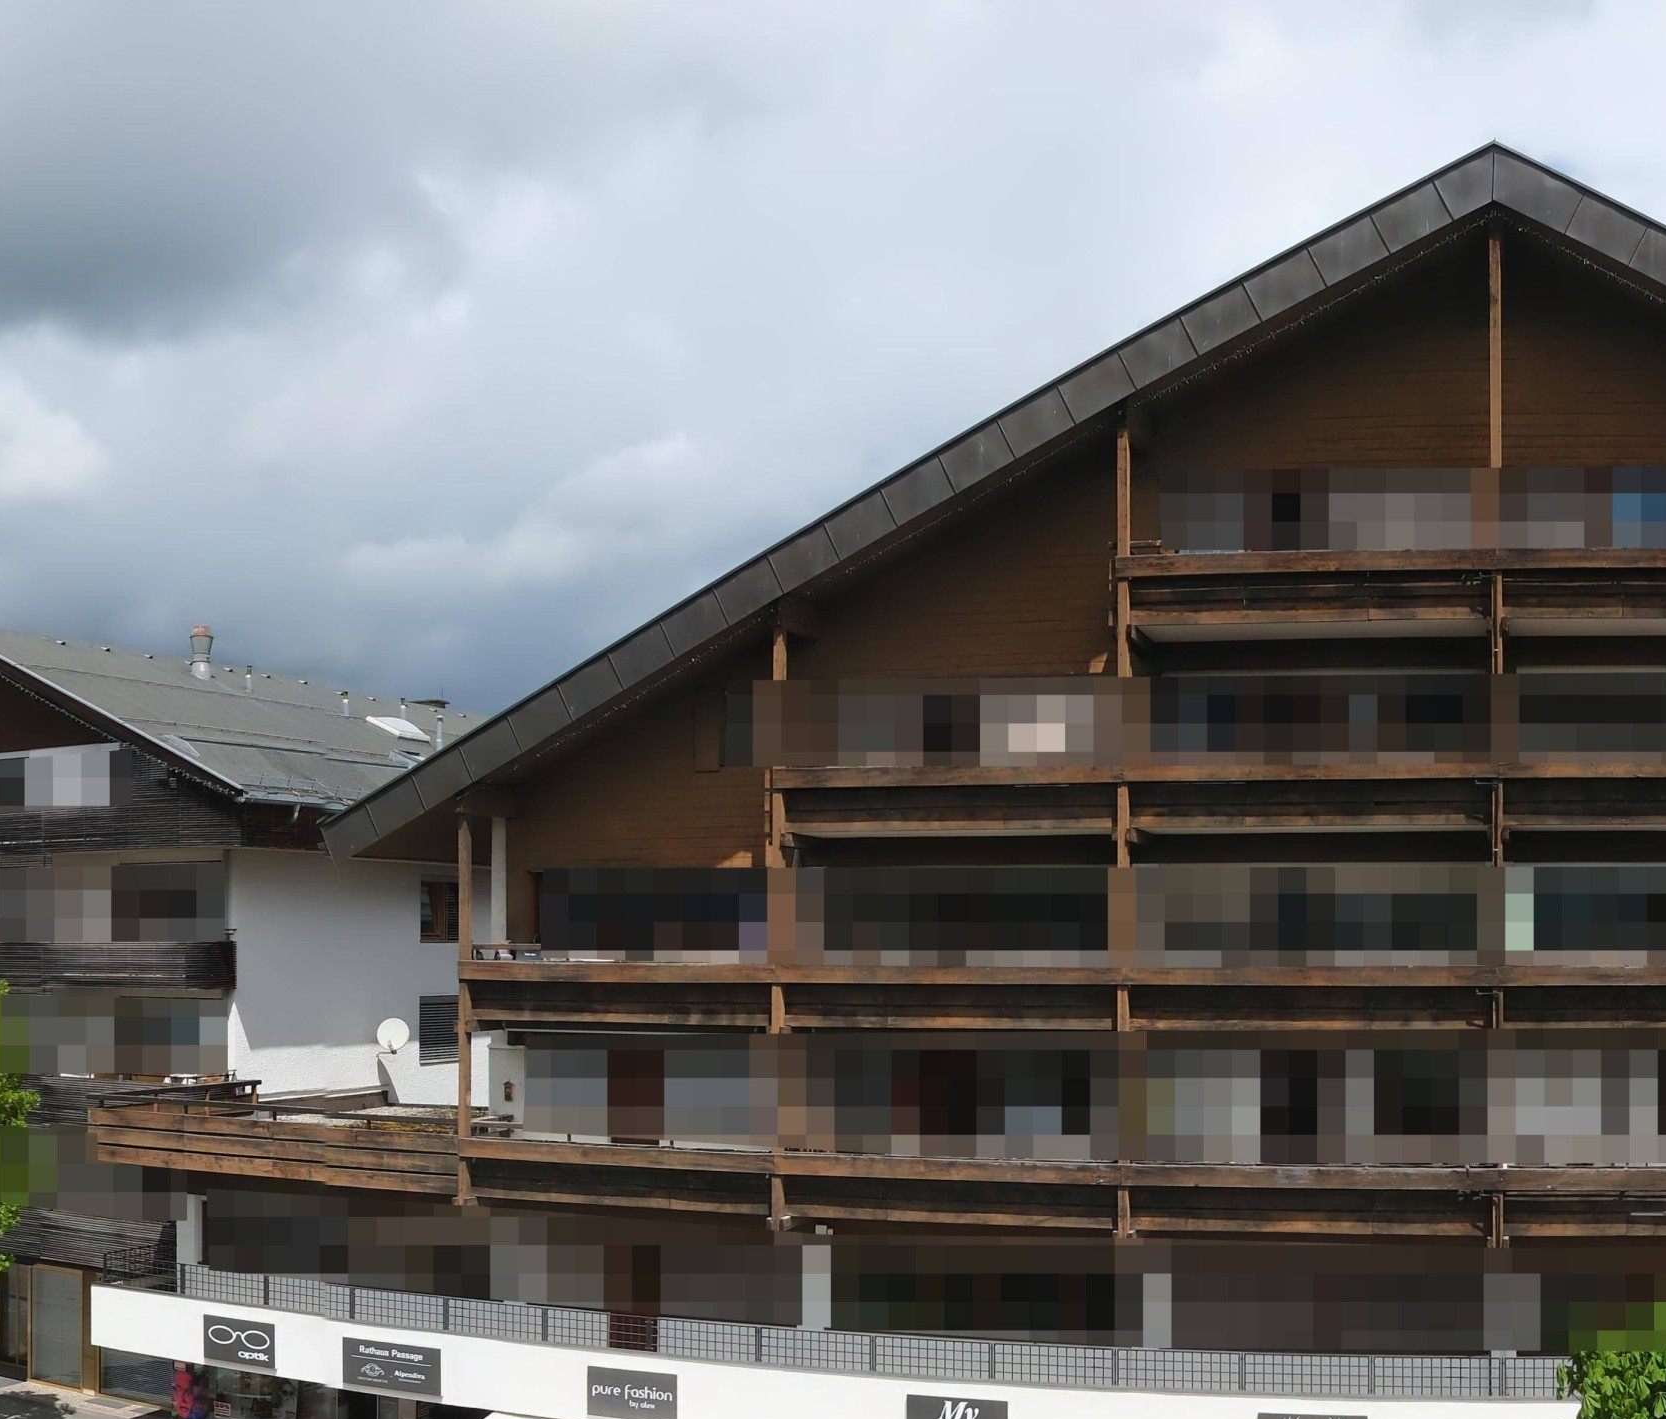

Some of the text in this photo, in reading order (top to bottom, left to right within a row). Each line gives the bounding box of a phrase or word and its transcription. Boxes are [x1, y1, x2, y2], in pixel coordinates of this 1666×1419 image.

[238, 1350, 269, 1362] optik
[359, 1345, 423, 1361] Rathaus Passage
[592, 1384, 673, 1401] pure fashion
[629, 1400, 638, 1409] by
